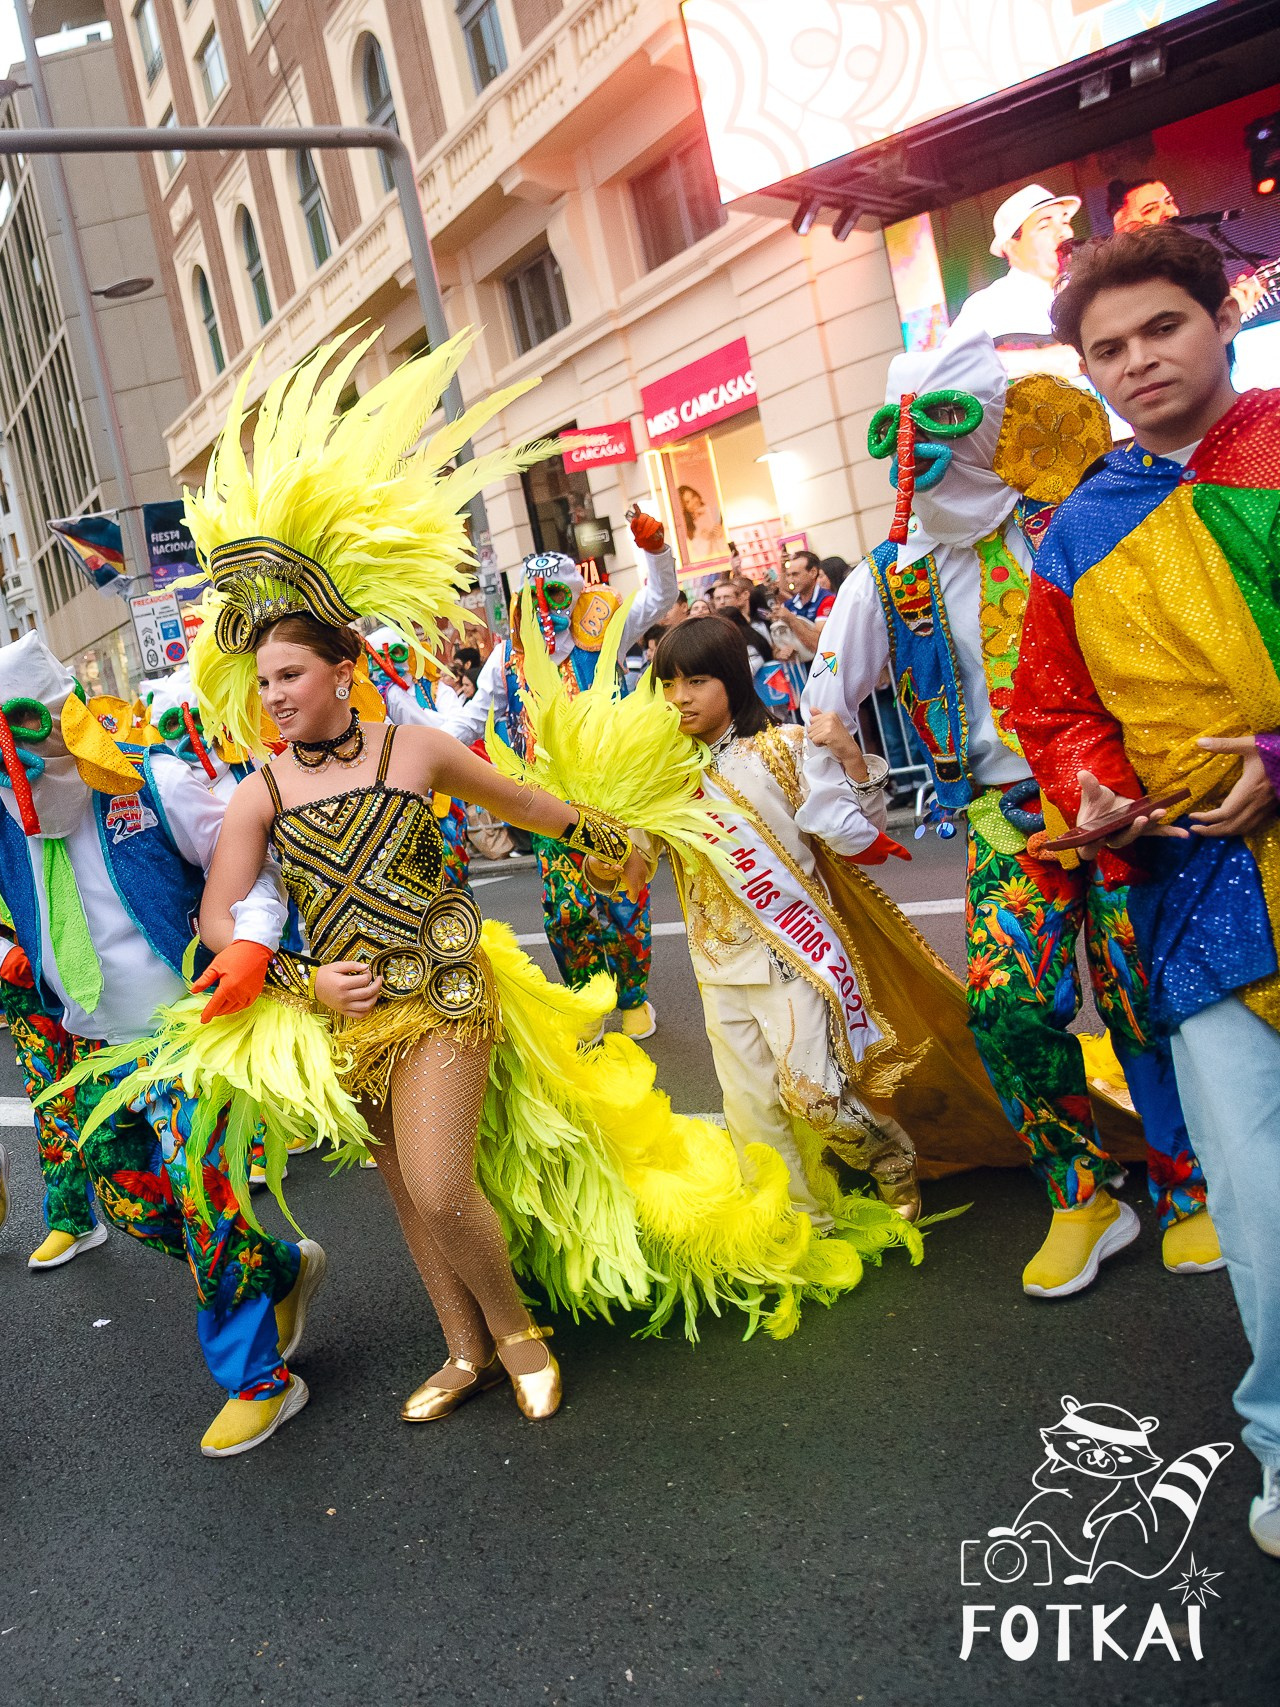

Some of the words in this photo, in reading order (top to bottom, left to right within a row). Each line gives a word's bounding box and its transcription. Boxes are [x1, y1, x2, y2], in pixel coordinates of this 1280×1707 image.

[646, 406, 680, 439] MISS
[680, 370, 758, 423] CARCASAS
[571, 442, 627, 463] CARCASAS
[151, 530, 180, 543] FIESTA
[740, 868, 781, 910] los
[773, 900, 831, 962] Niños
[827, 956, 869, 1031] 2027
